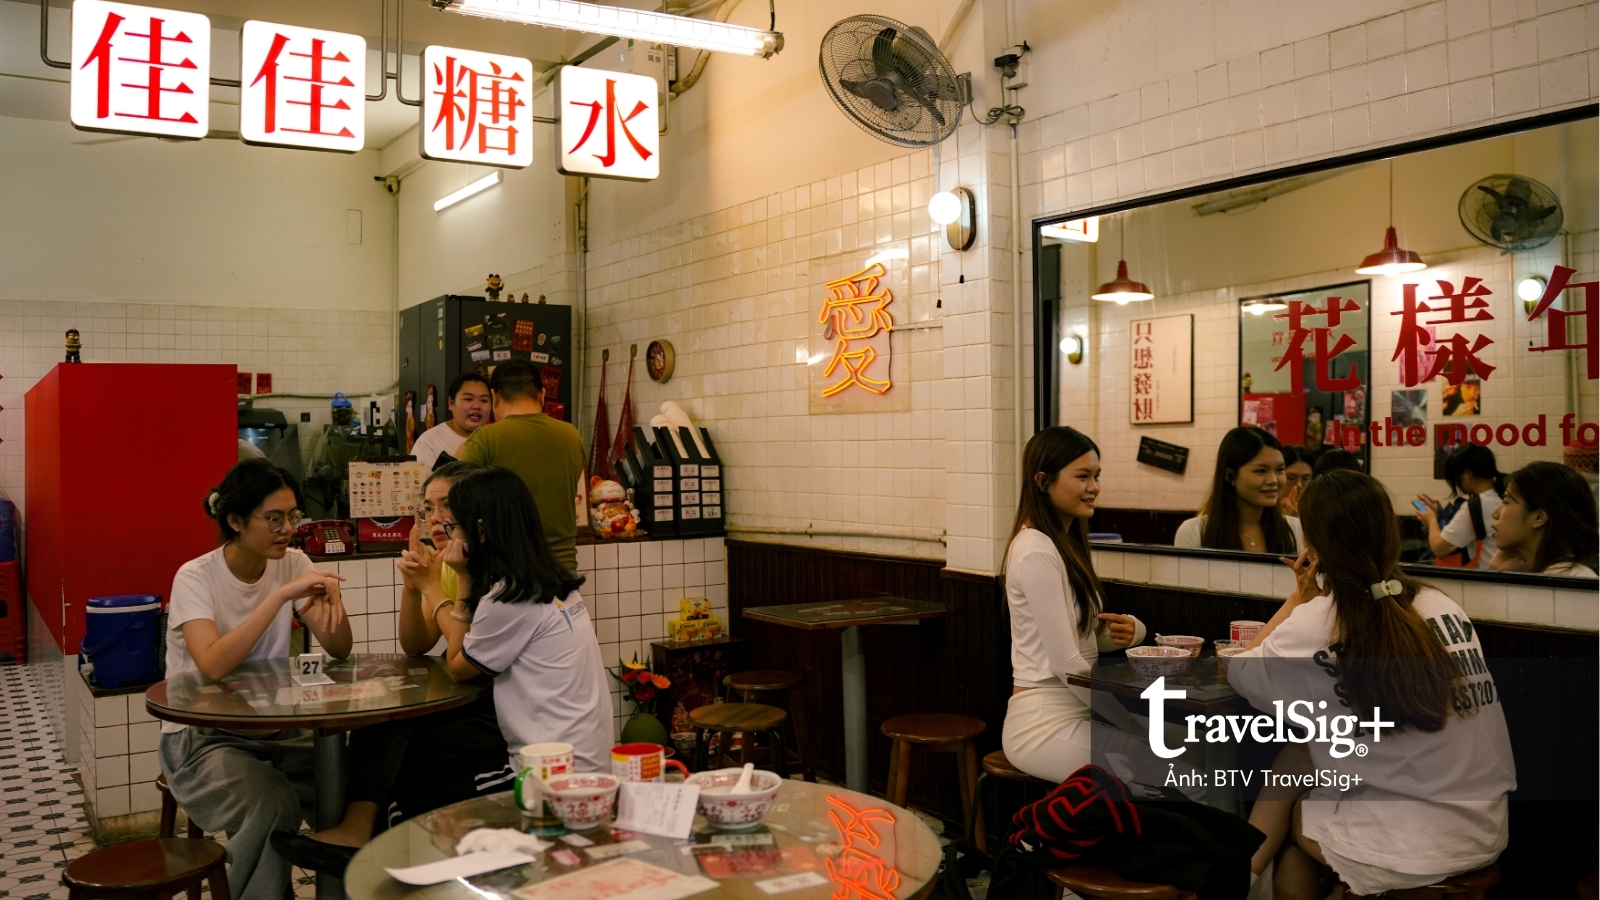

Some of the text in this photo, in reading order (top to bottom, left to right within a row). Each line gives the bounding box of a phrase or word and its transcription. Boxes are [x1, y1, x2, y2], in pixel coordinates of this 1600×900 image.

[81, 12, 653, 168] 佳佳糖水
[819, 262, 893, 397] 愛
[1334, 419, 1361, 446] In
[1369, 416, 1426, 446] the
[1436, 413, 1546, 447] mood
[302, 661, 320, 675] 27
